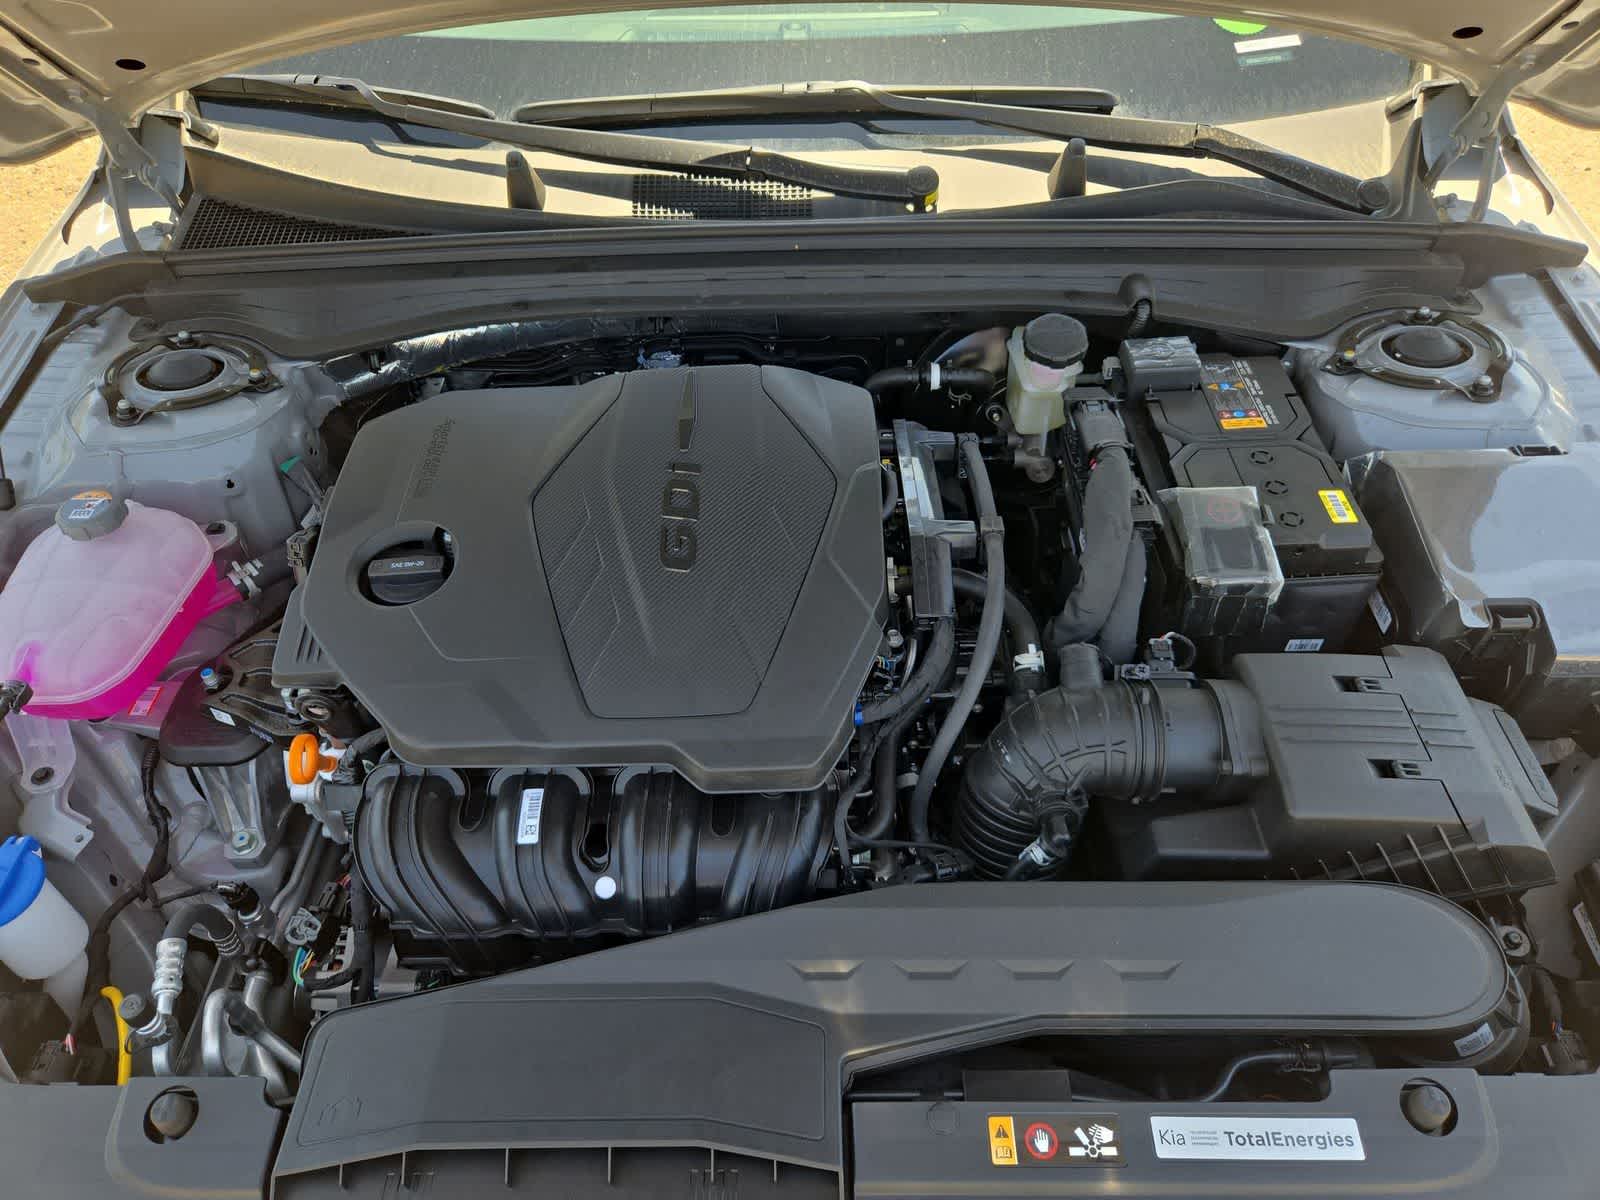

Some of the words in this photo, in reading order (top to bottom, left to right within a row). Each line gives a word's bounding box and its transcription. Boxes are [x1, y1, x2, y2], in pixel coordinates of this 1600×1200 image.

[660, 462, 701, 573] GDI
[391, 561, 403, 569] SAE
[1158, 1128, 1186, 1146] Kia
[1223, 1130, 1355, 1150] TotalEnergies
